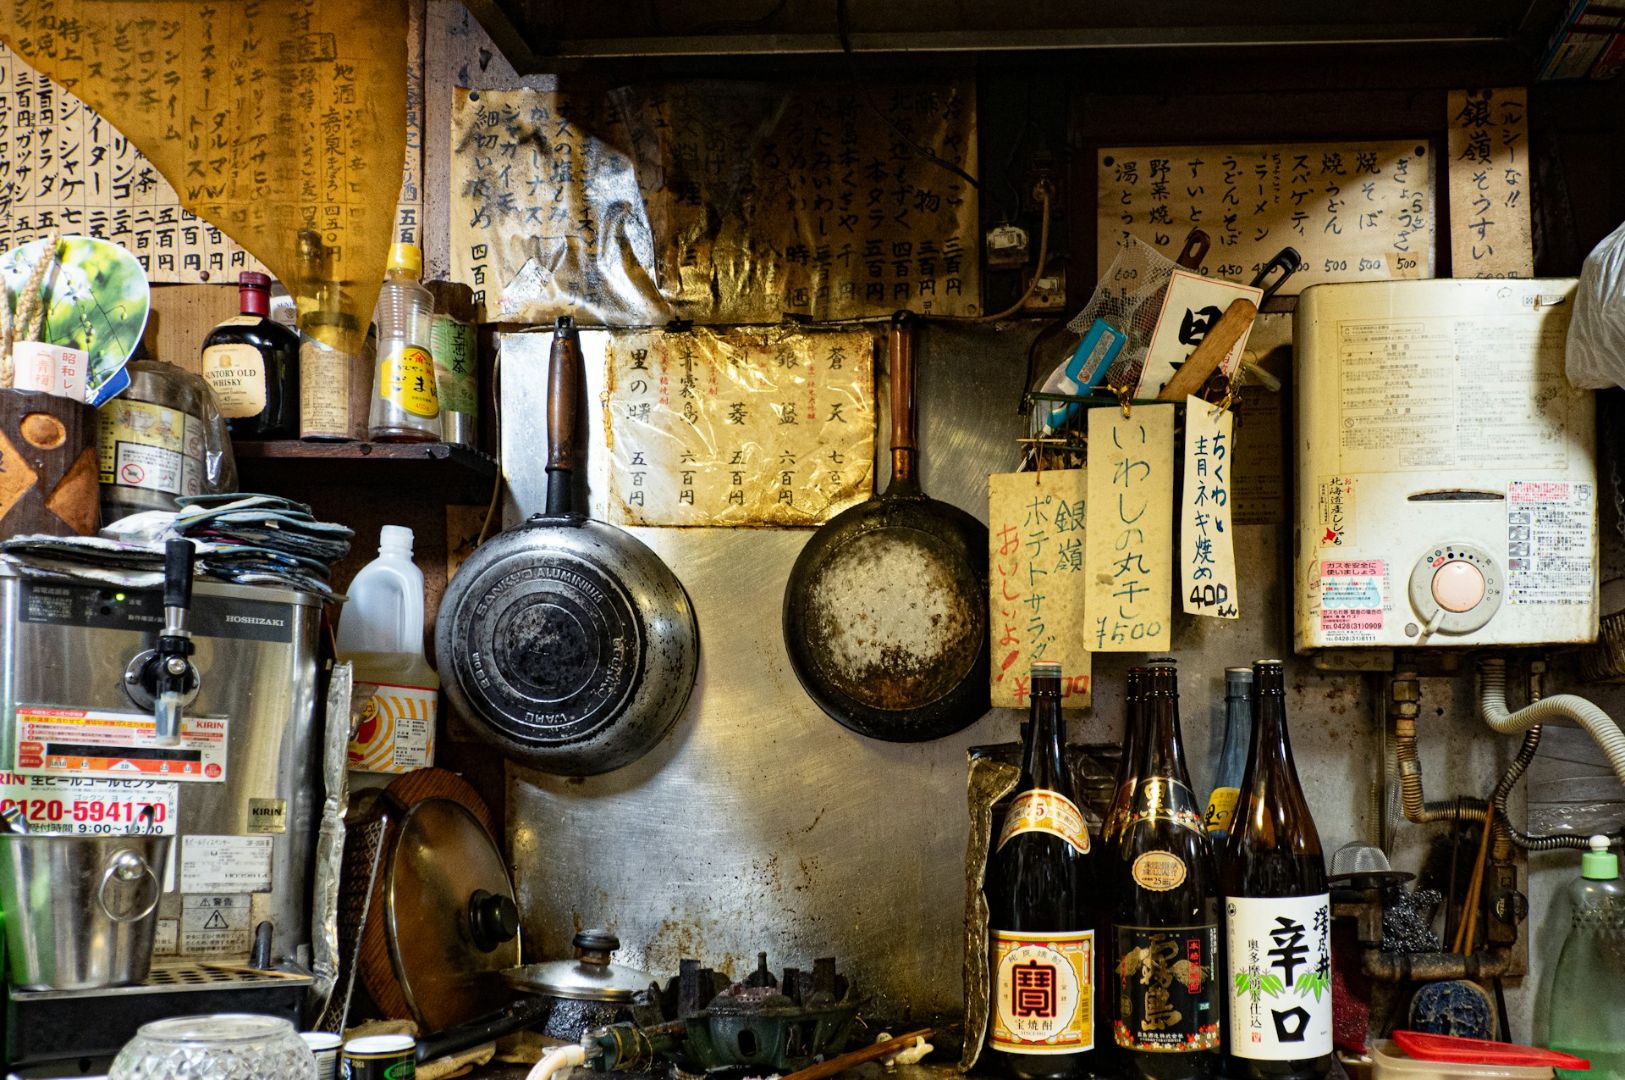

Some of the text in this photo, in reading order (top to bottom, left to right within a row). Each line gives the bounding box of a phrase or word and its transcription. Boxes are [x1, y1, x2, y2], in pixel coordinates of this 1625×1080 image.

[15, 72, 33, 126] 三百円
[36, 74, 54, 124] 三百円
[36, 126, 59, 198] サラダ
[526, 106, 549, 224] かしナス
[1319, 151, 1347, 235] 焼うどん
[1354, 152, 1383, 231] 焼そば
[135, 210, 156, 273] 二百円
[155, 207, 179, 271] 五百円
[180, 208, 201, 271] 四百円
[1324, 258, 1348, 273] 500
[1358, 258, 1382, 272] 500
[1396, 257, 1417, 270] 500
[470, 244, 488, 308] 四百円
[891, 241, 913, 302] 四百円
[1217, 263, 1243, 277] 450
[62, 352, 77, 397] 昭和レ
[212, 378, 242, 387] WHISKY
[236, 368, 257, 378] OLD
[629, 451, 648, 507] 五百円
[679, 451, 698, 506] 六百円
[728, 450, 747, 506] 五百円
[778, 450, 796, 505] 六百円
[1210, 429, 1227, 534] ちくわと
[1111, 425, 1152, 621] いわしの丸干し
[475, 566, 605, 617] SANKYO ALUMINIUM
[1024, 495, 1056, 660] ポテトサラダ
[1326, 561, 1377, 569] ガスを安全に
[225, 614, 285, 628] HOSHIZAKI
[1189, 583, 1228, 610] 400
[195, 720, 225, 730] KIRIN
[252, 807, 282, 818] KIRIN
[212, 897, 233, 907] 警告
[1267, 916, 1312, 1043] 辛口
